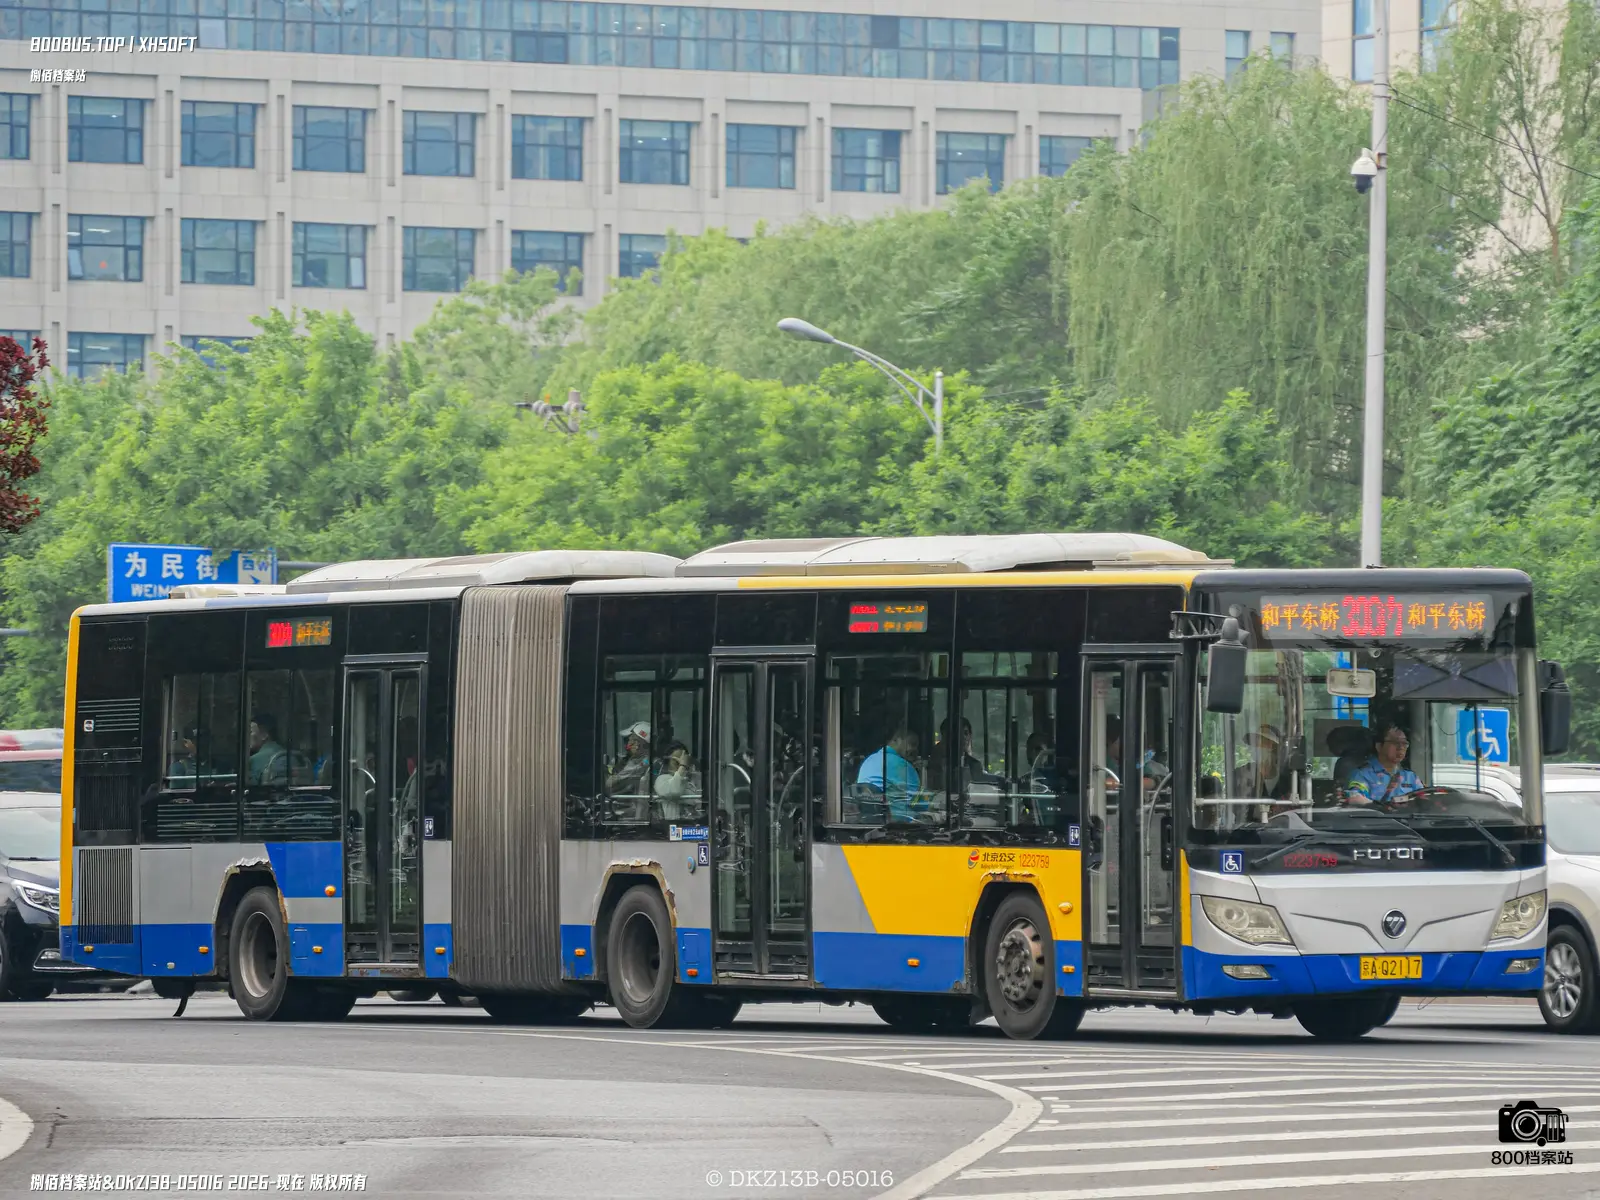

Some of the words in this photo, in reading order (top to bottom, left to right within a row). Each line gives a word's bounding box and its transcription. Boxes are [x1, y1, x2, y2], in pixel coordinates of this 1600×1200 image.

[125, 551, 219, 581] 为民街
[1261, 602, 1340, 631] 和平东桥
[1408, 601, 1486, 631] 和平东桥
[982, 852, 1015, 863] 北京公交
[1019, 853, 1050, 869] 1223759
[1353, 847, 1424, 861] FOTON
